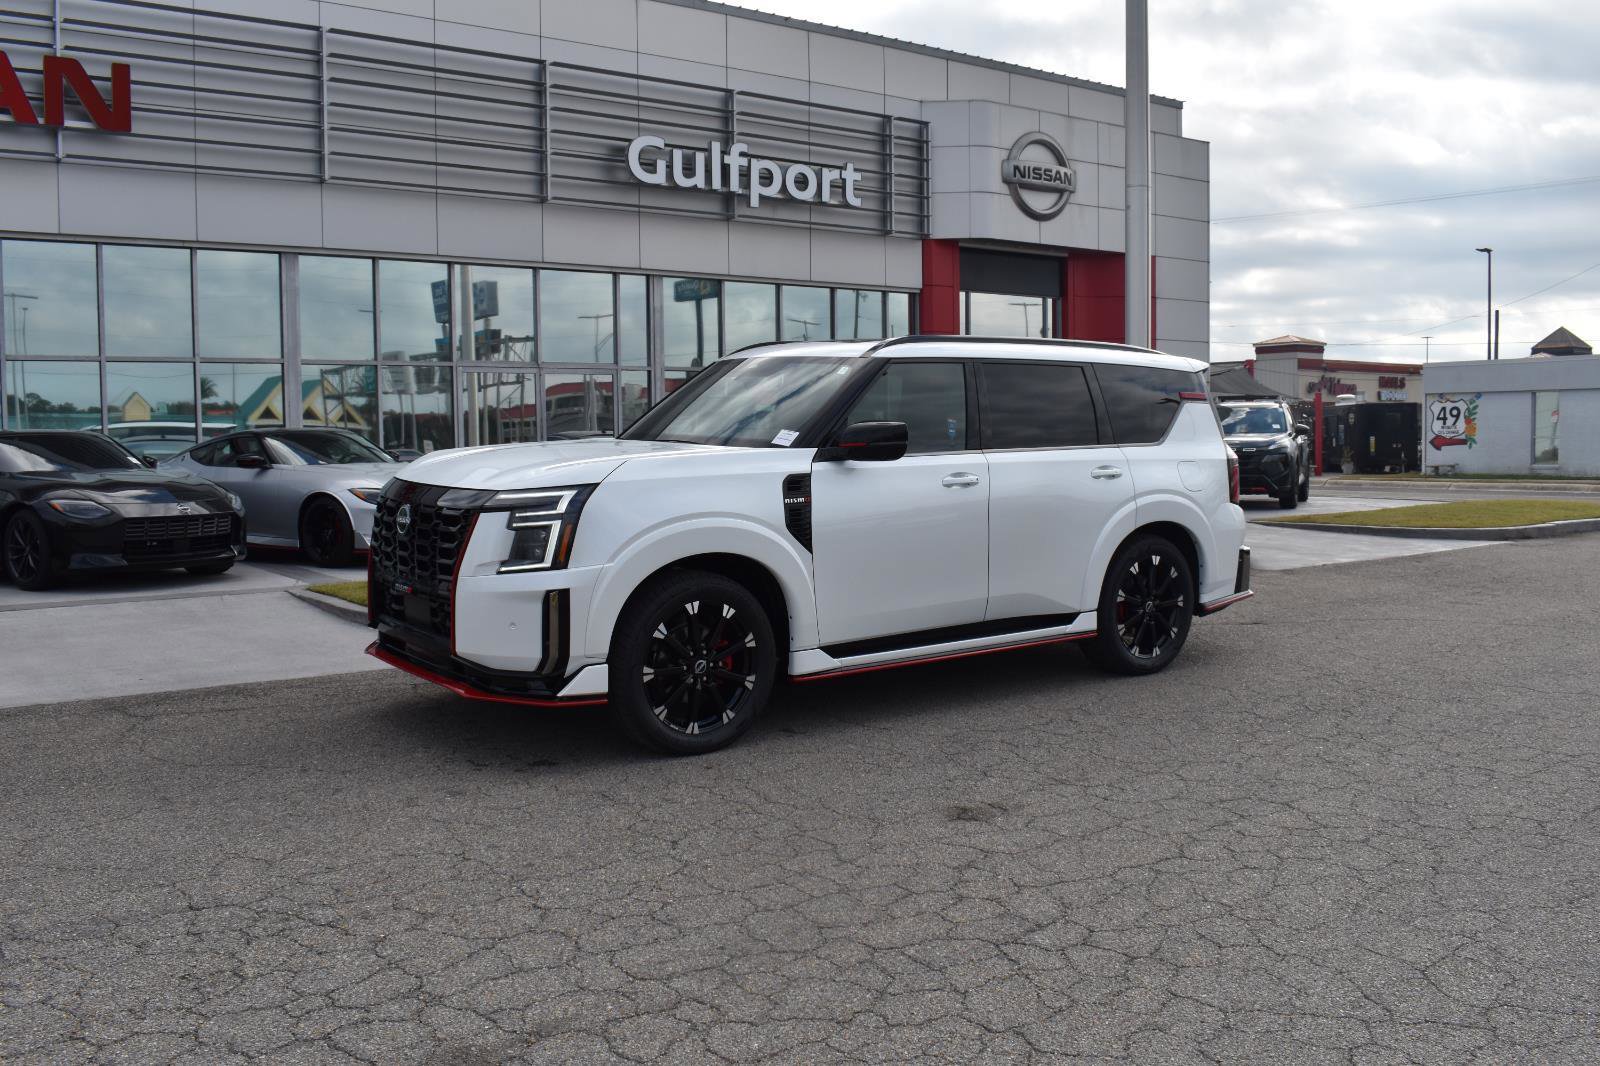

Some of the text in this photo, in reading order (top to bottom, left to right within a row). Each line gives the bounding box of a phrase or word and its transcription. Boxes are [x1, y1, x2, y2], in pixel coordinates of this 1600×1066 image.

[628, 136, 862, 208] Gulfport
[1013, 164, 1072, 187] NISSAN
[1436, 406, 1462, 426] 49
